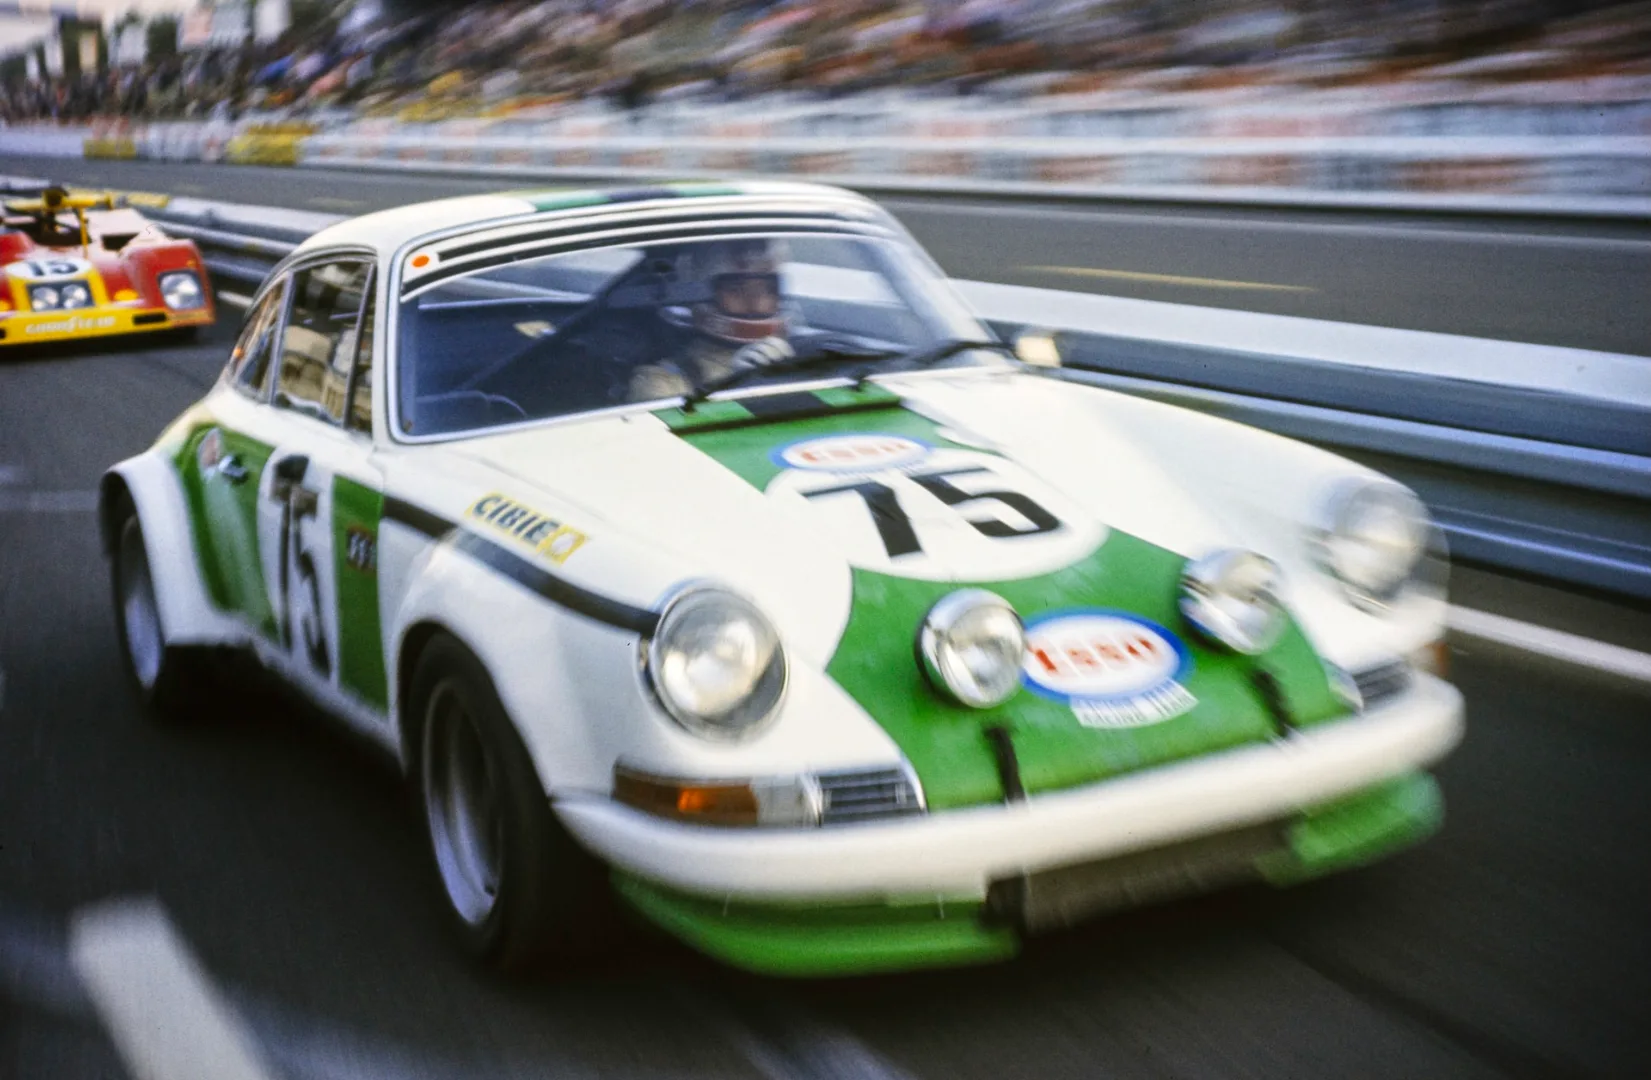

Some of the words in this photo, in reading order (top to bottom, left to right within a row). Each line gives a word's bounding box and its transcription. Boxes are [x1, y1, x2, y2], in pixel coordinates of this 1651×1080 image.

[28, 260, 79, 277] 15
[473, 495, 559, 545] CIBIE
[798, 466, 1062, 559] 75
